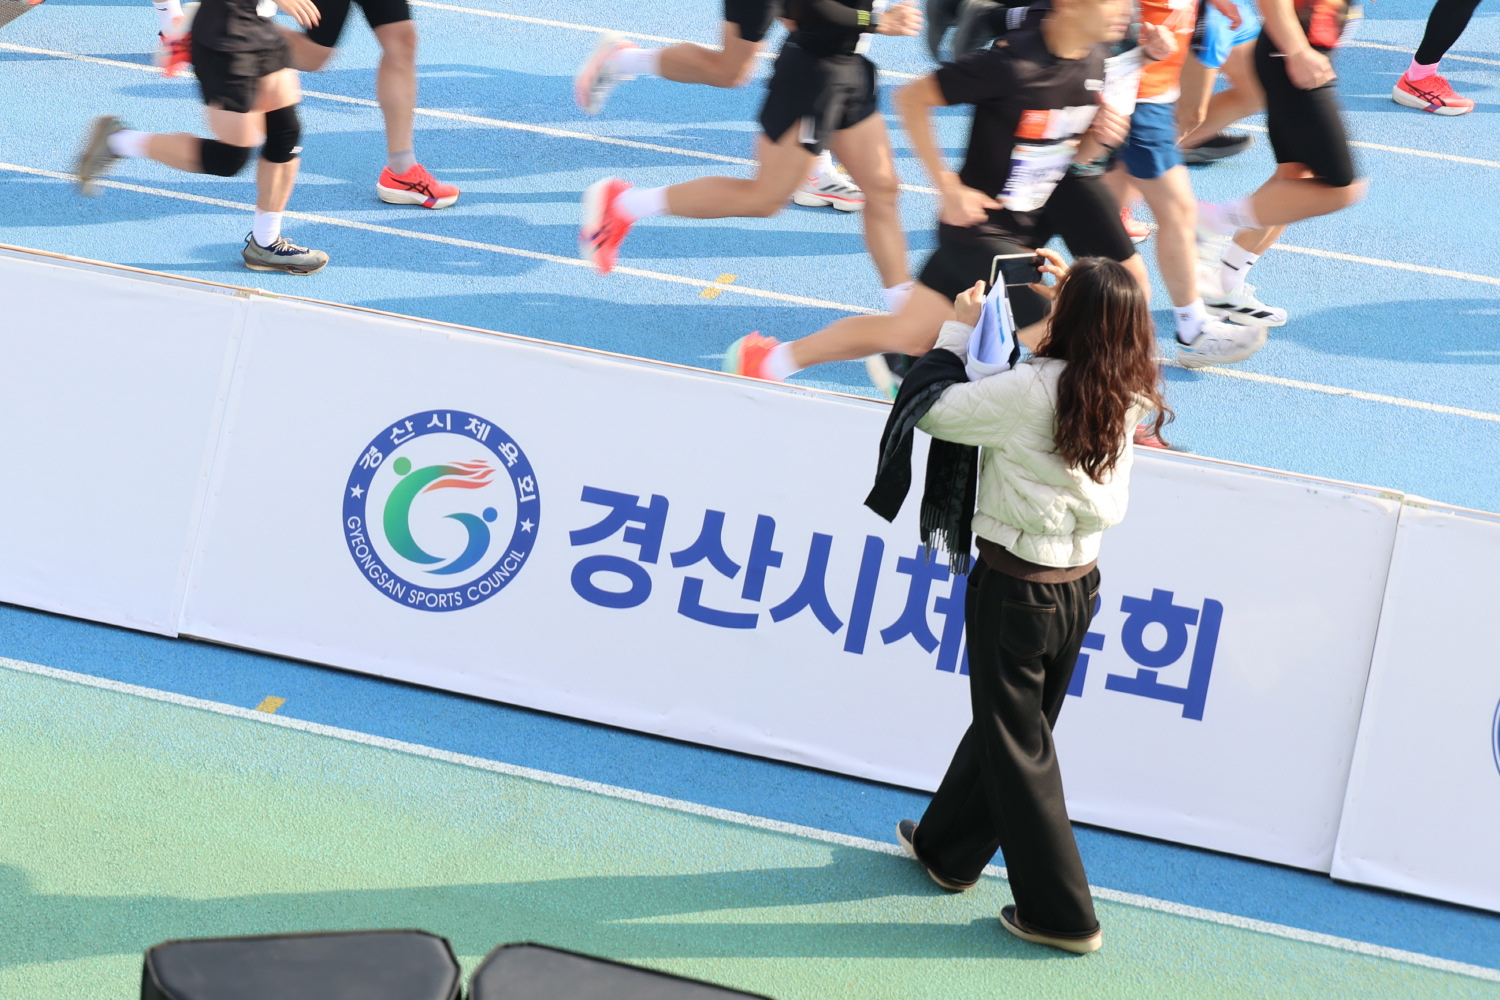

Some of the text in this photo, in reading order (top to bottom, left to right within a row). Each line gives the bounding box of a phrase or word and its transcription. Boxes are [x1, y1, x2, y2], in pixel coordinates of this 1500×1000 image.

[359, 413, 537, 503] 경산시체육회
[347, 515, 526, 609] GYEONGSAN SPORTS COUNCIL
[569, 484, 1223, 722] 경산시체회
